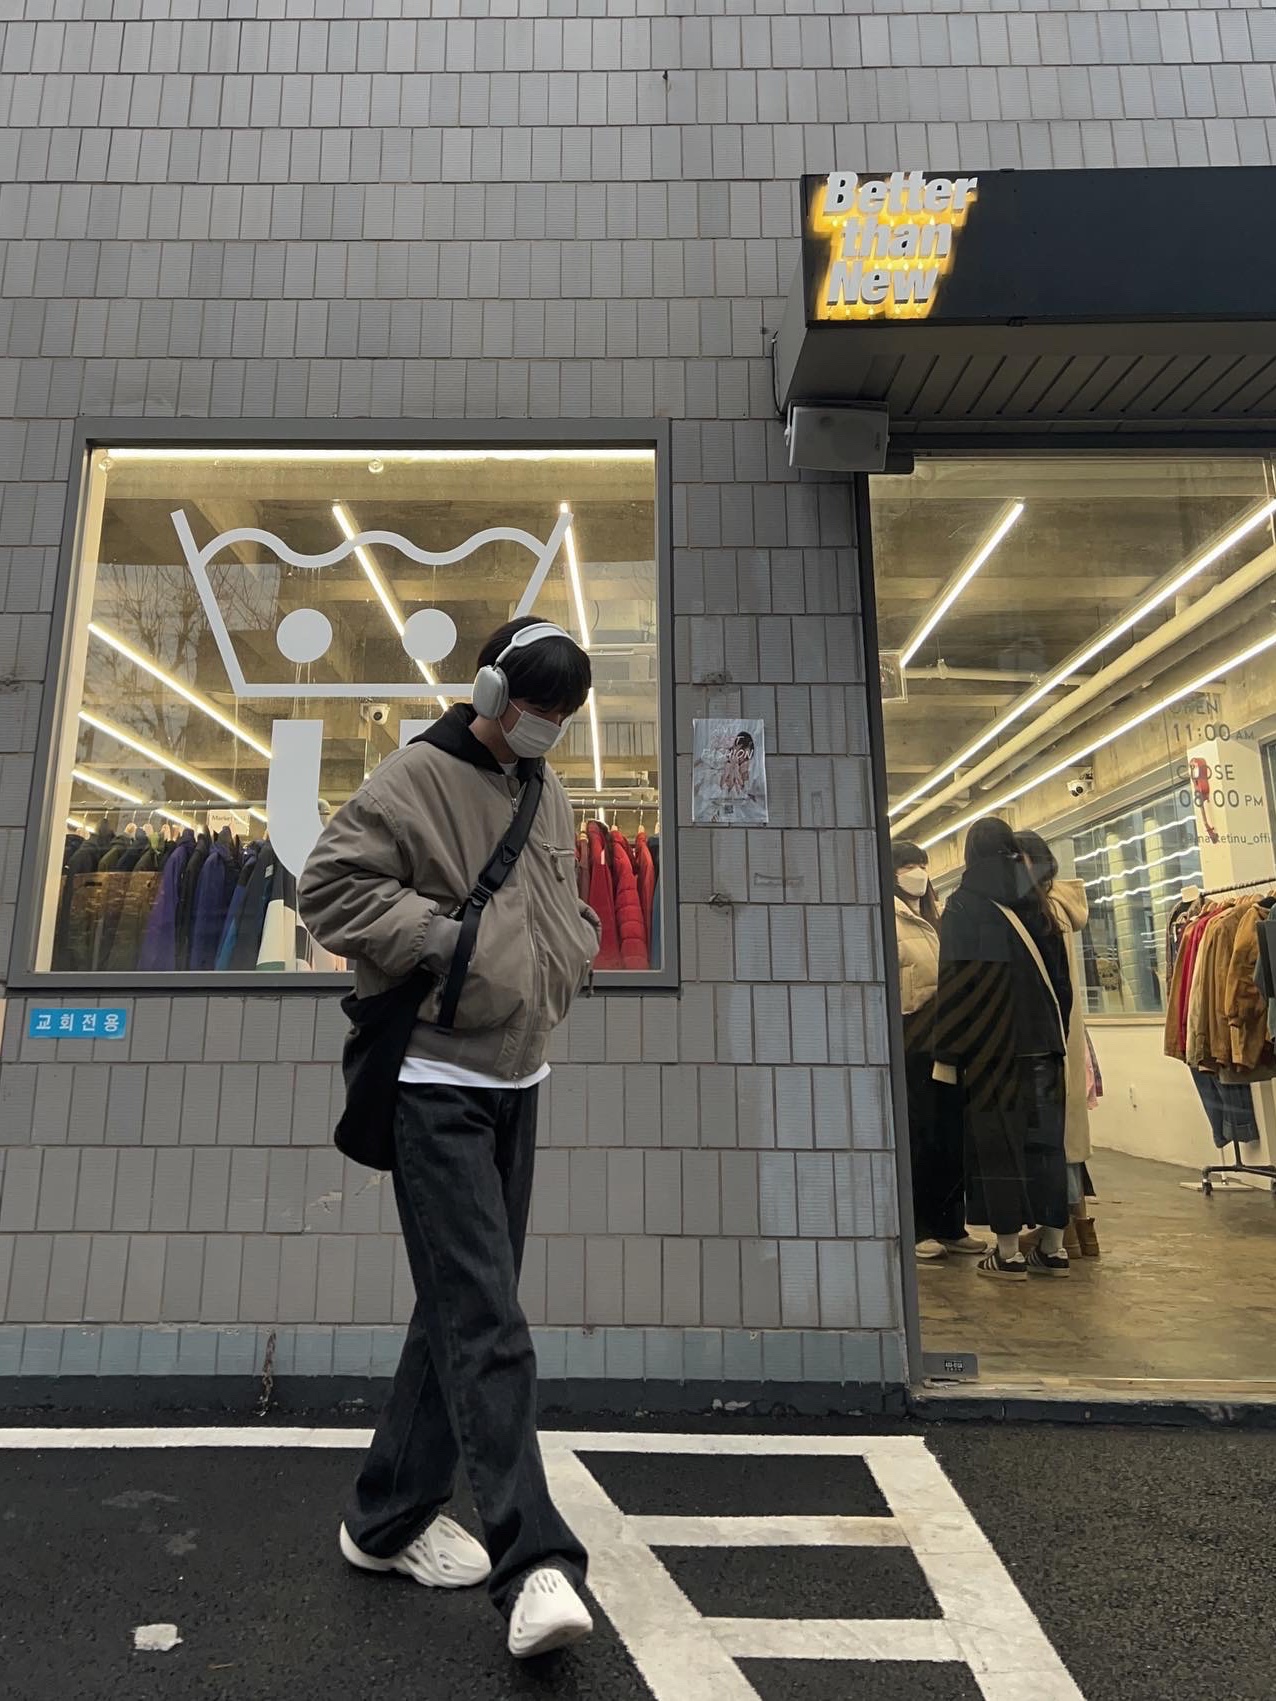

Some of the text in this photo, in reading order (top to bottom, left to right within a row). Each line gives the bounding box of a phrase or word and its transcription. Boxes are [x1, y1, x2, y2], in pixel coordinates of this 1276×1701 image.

[823, 171, 978, 216] Better
[842, 216, 952, 258] than
[826, 260, 939, 305] New
[1170, 699, 1218, 714] OPEN
[1173, 723, 1255, 742] 11:00 AM
[1176, 764, 1235, 781] CLOSE
[1245, 794, 1264, 807] PM
